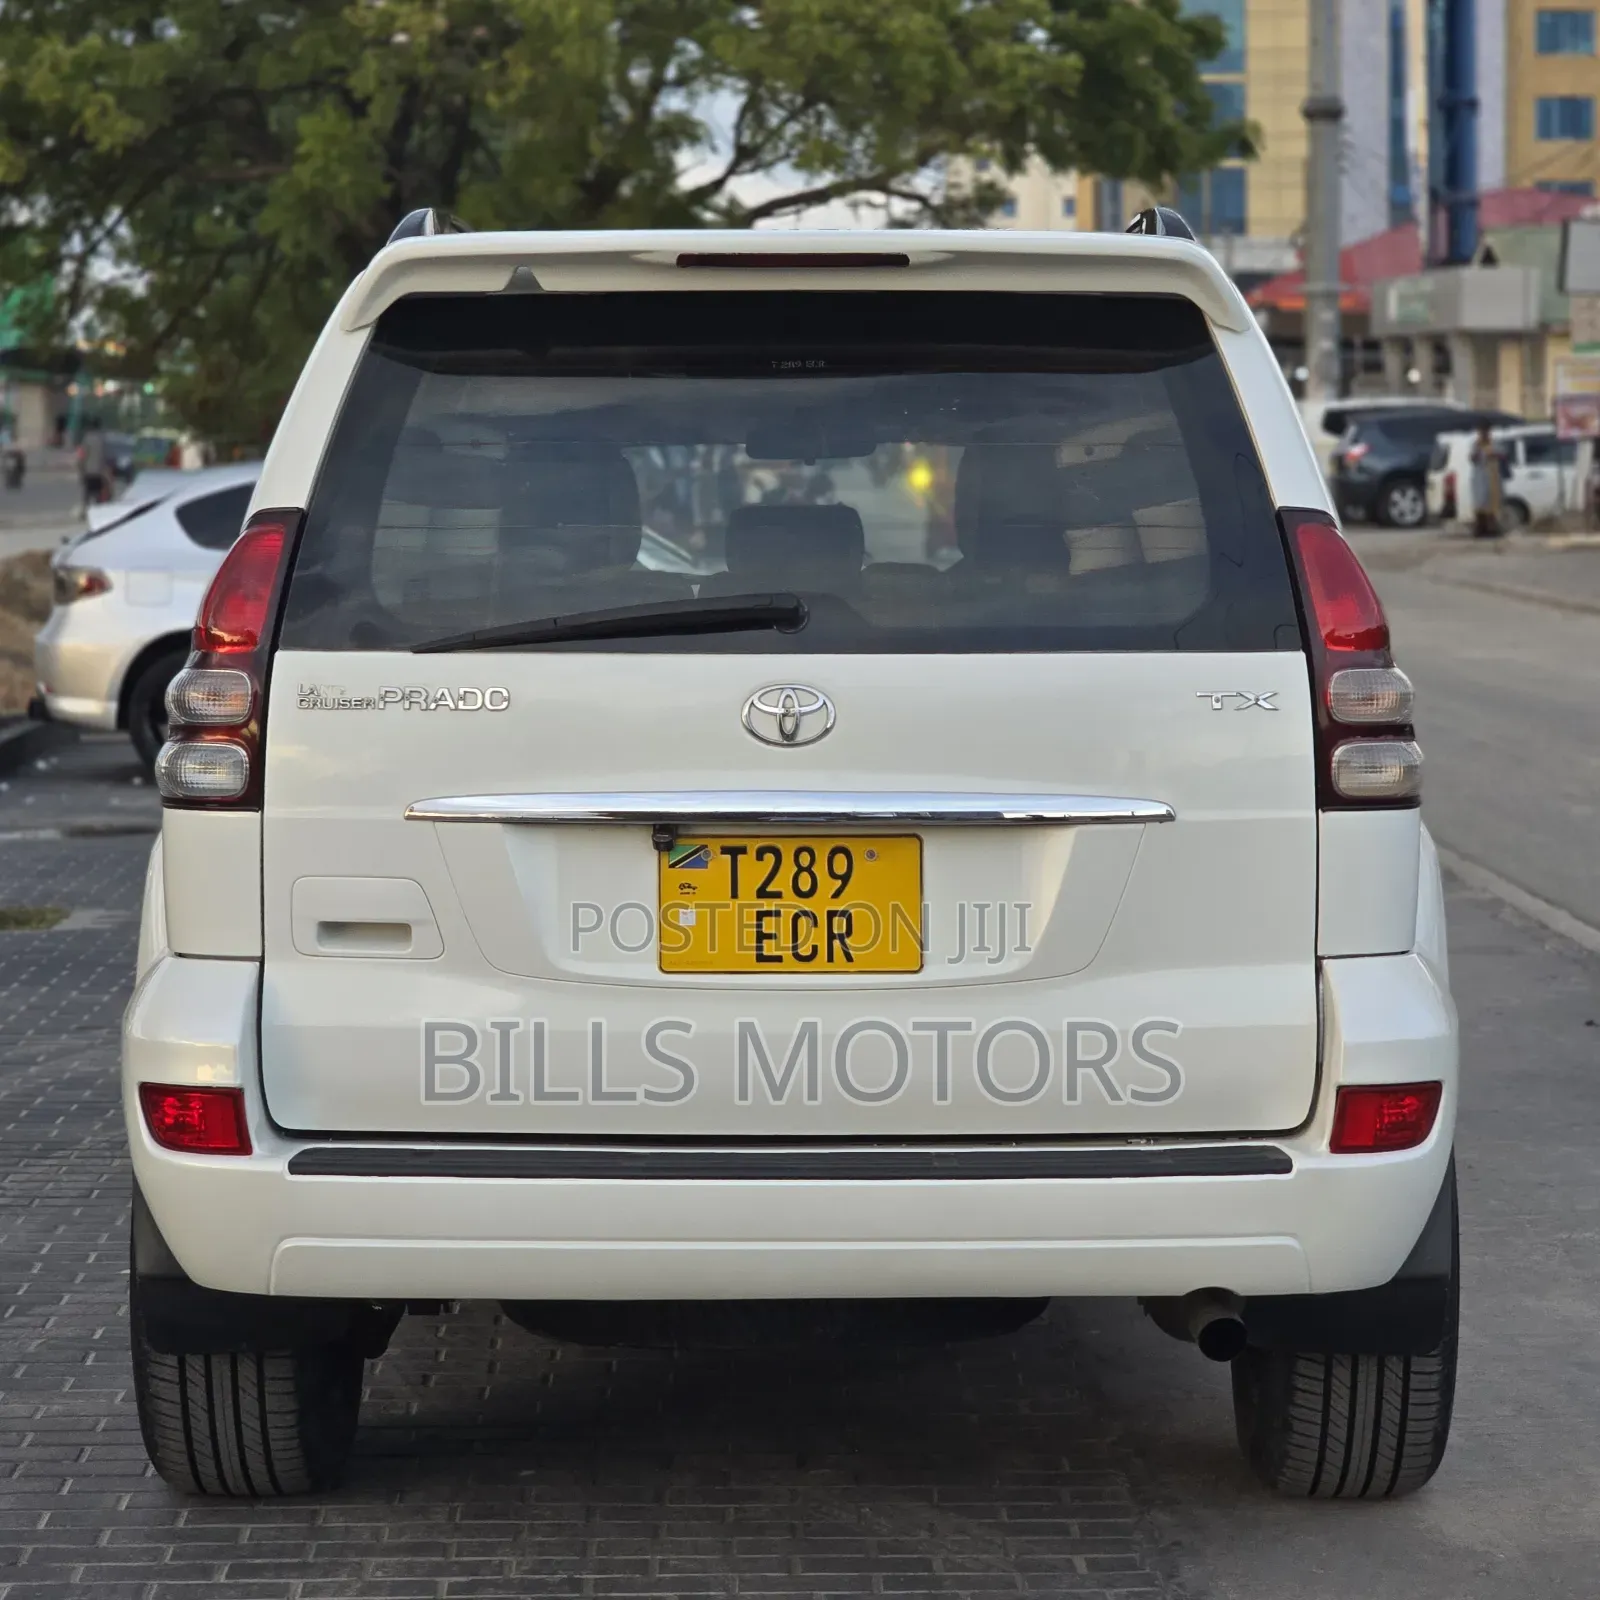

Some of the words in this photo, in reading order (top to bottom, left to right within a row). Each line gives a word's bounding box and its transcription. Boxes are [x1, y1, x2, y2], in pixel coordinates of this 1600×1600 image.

[297, 697, 376, 710] CRUISER
[377, 686, 510, 711] PRADO
[1196, 691, 1280, 711] TX
[720, 845, 855, 899] T289
[755, 910, 855, 963] ECR
